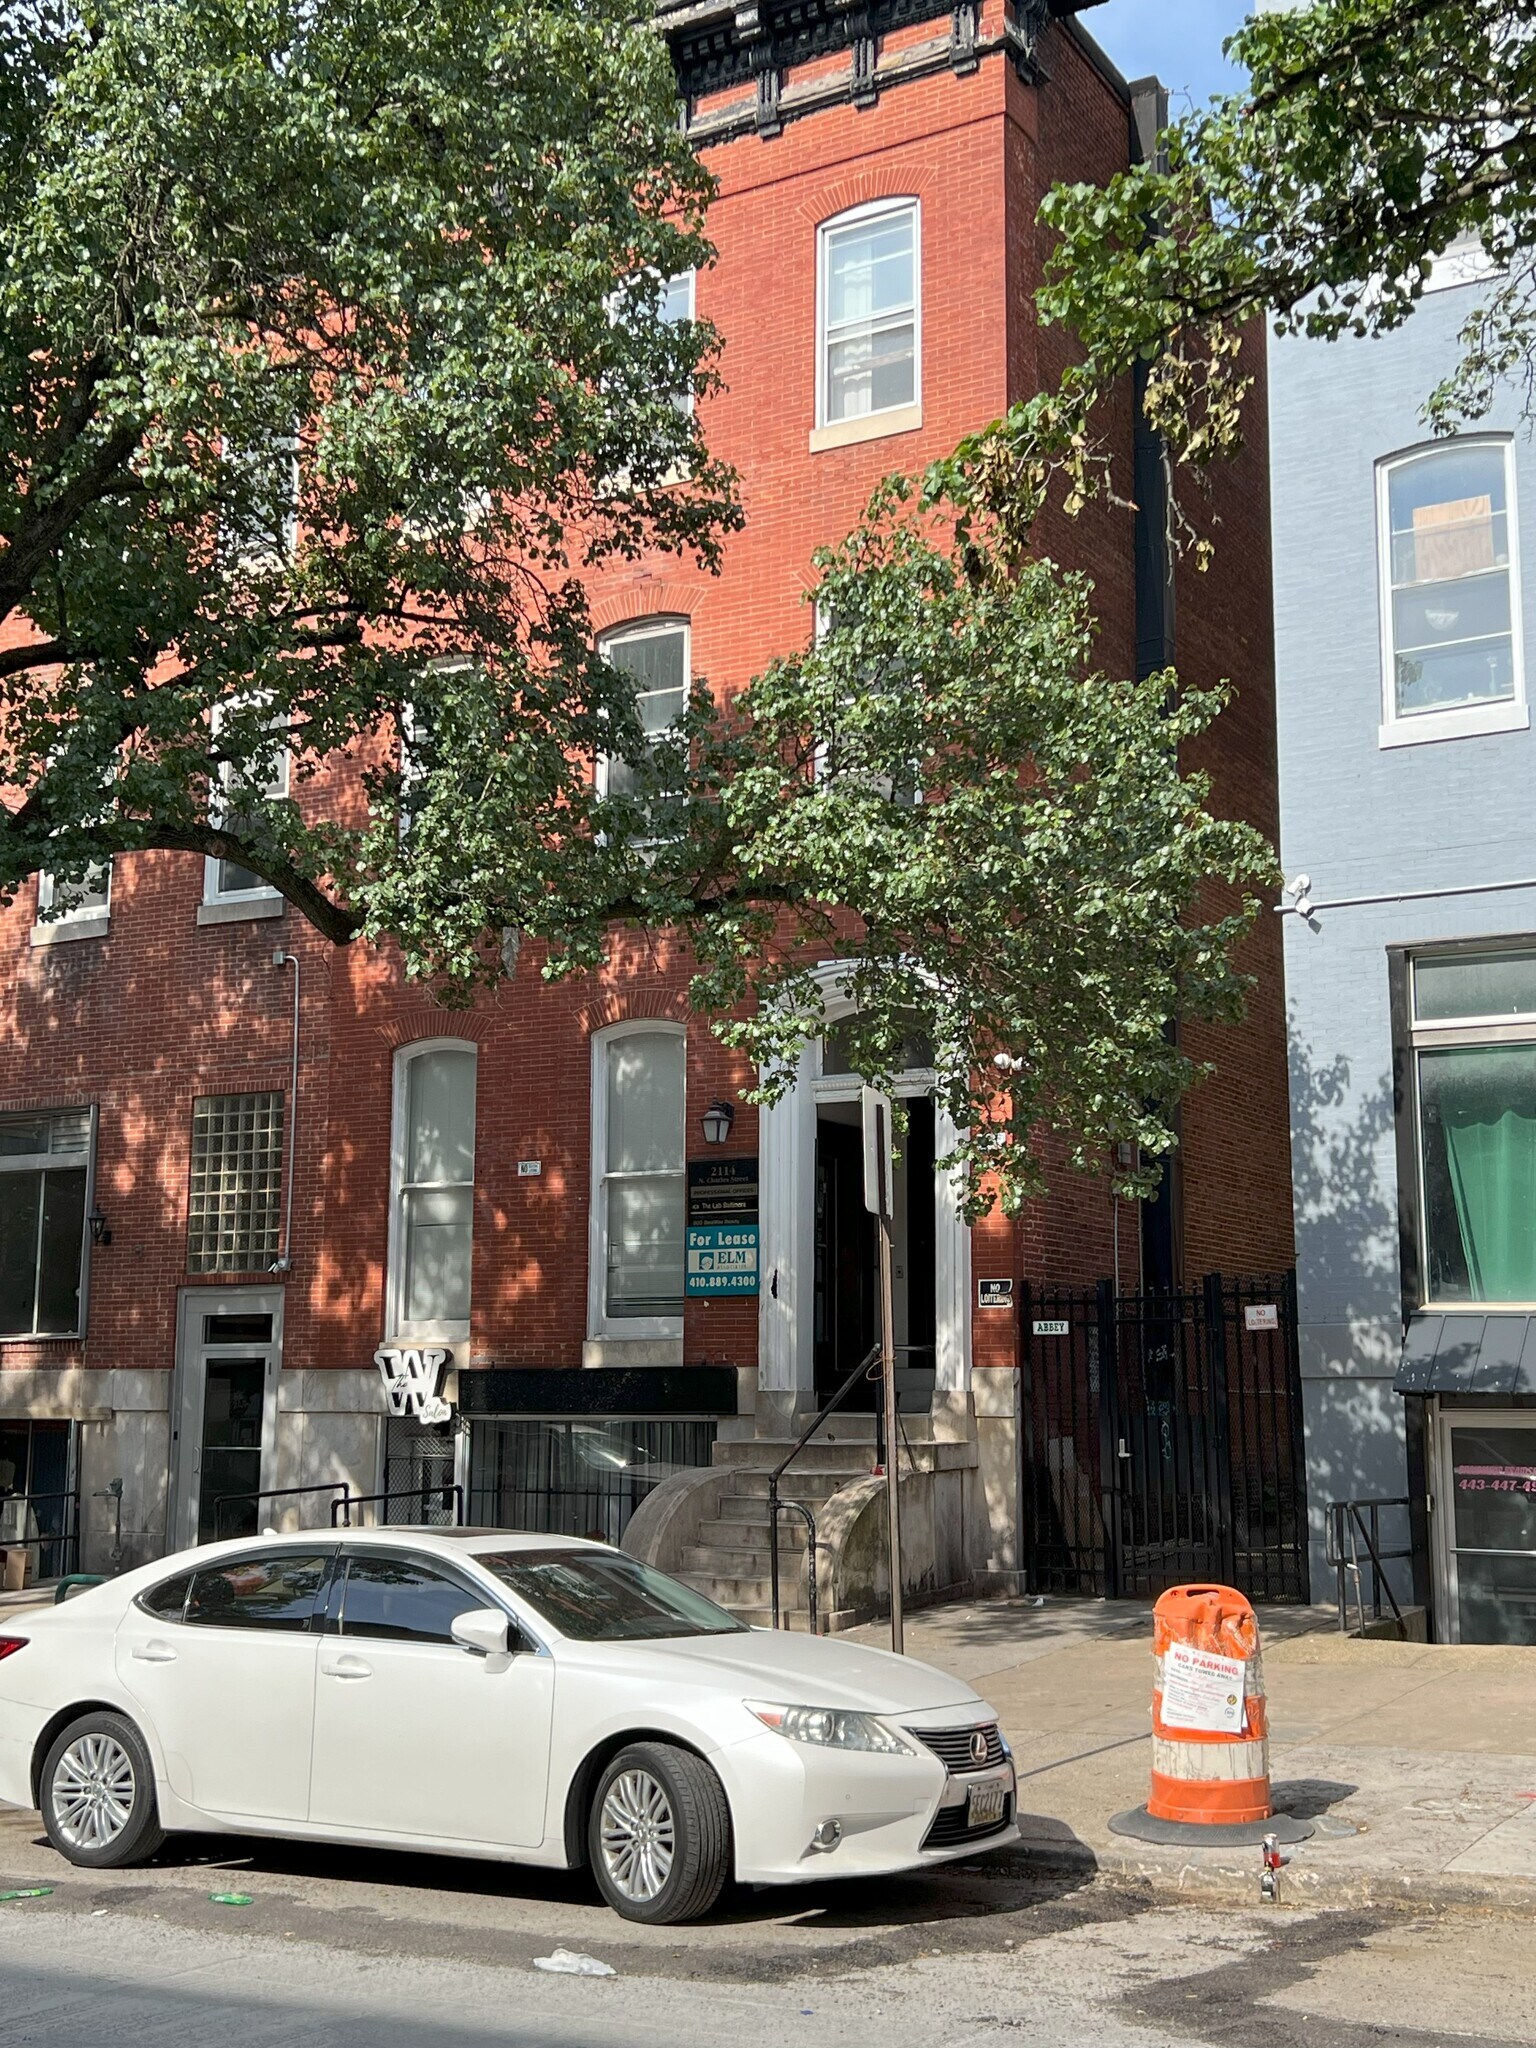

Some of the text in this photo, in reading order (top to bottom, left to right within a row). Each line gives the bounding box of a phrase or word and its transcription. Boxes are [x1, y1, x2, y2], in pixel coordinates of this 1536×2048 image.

[689, 1232, 756, 1246] For Lease
[718, 1251, 746, 1264] ELM
[689, 1276, 756, 1287] 410.889.4300
[990, 1283, 1001, 1293] NO
[1037, 1323, 1065, 1332] ABBEY
[1174, 1652, 1239, 1676] NO PARKING
